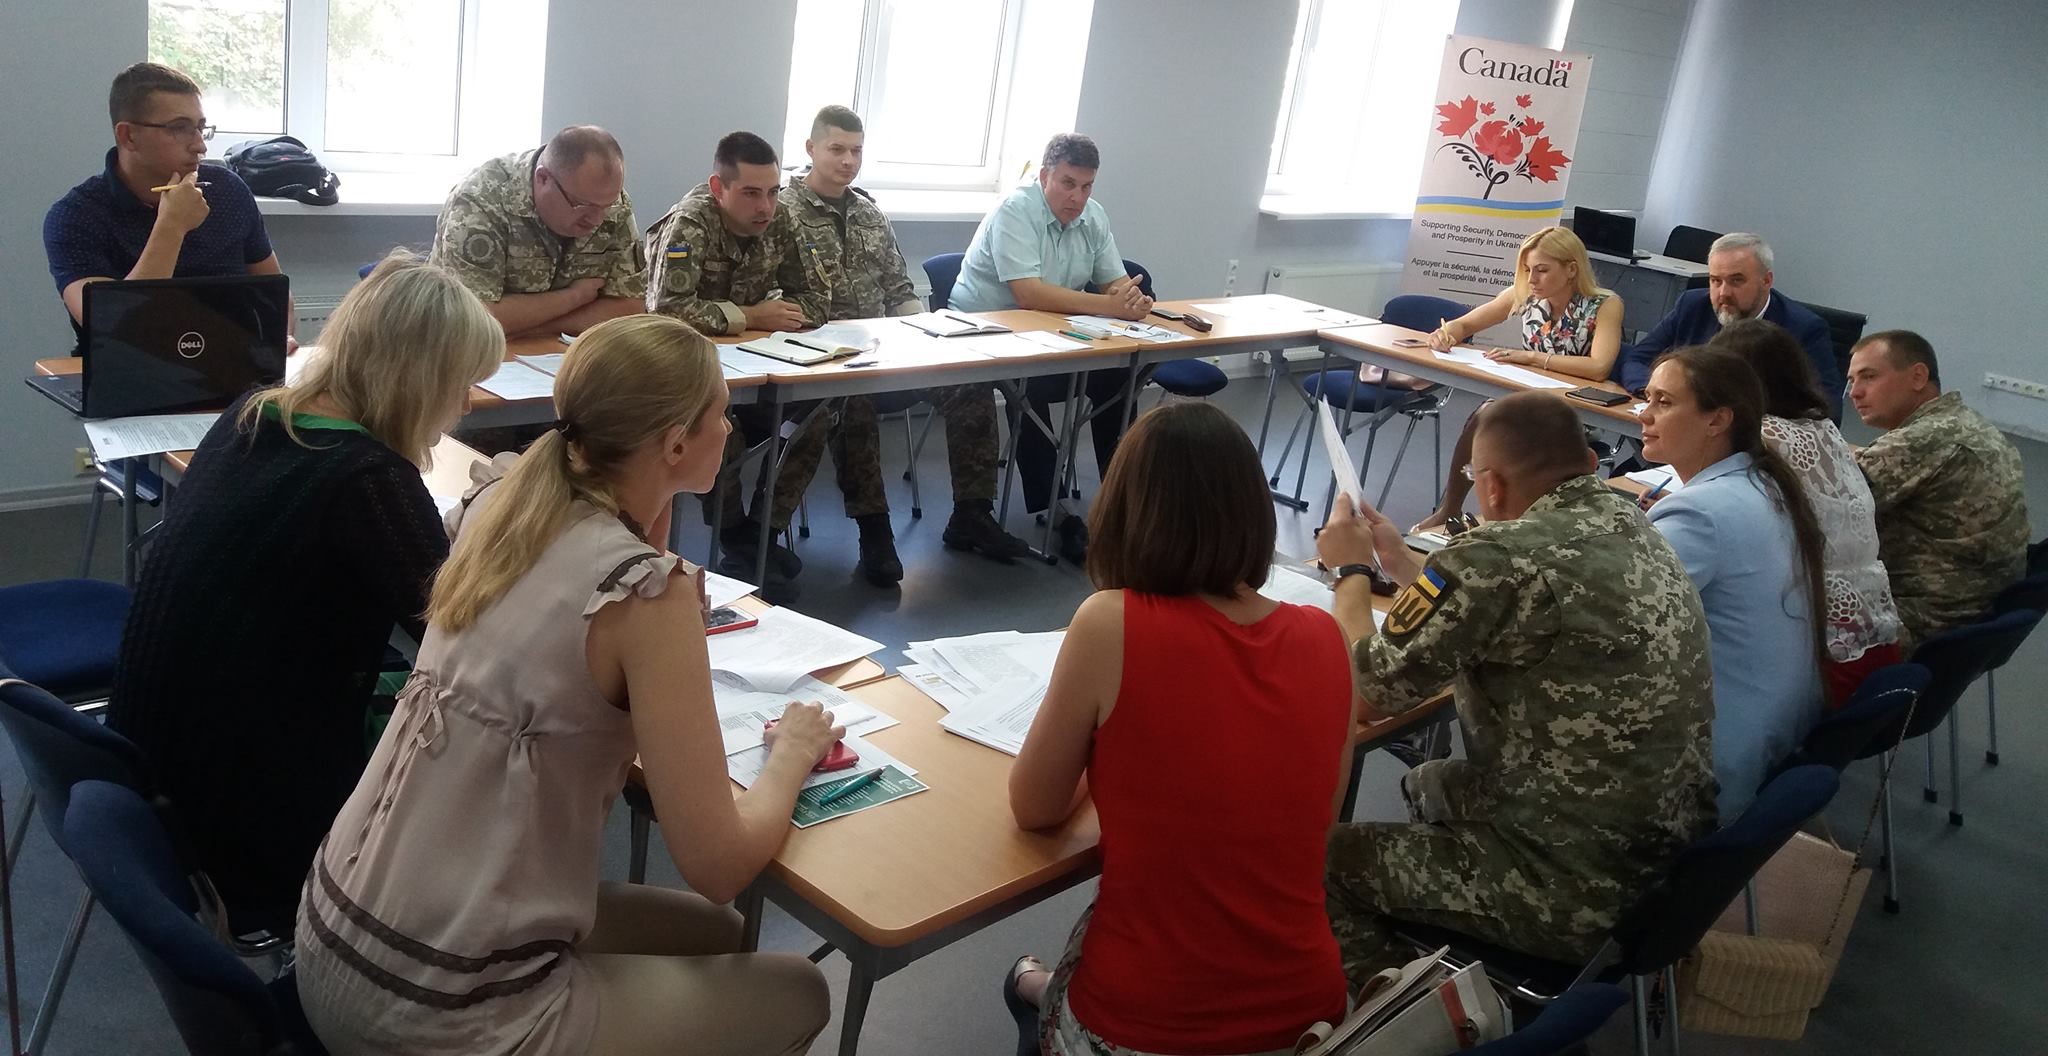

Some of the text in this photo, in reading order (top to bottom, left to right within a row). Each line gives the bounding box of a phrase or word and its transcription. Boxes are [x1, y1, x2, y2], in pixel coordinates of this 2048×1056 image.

[1459, 47, 1569, 88] Canada
[1421, 220, 1530, 240] Supporting Security, Democr
[1432, 232, 1446, 240] and
[1447, 233, 1485, 246] Prosperity
[1496, 240, 1521, 249] Ukrain
[1411, 257, 1441, 268] Appuyer
[1443, 261, 1450, 269] la
[1492, 268, 1516, 277] démoc
[1423, 269, 1431, 277] et
[1440, 272, 1476, 282] prospérité
[1490, 277, 1515, 286] Ukrain
[181, 341, 202, 349] DELL
